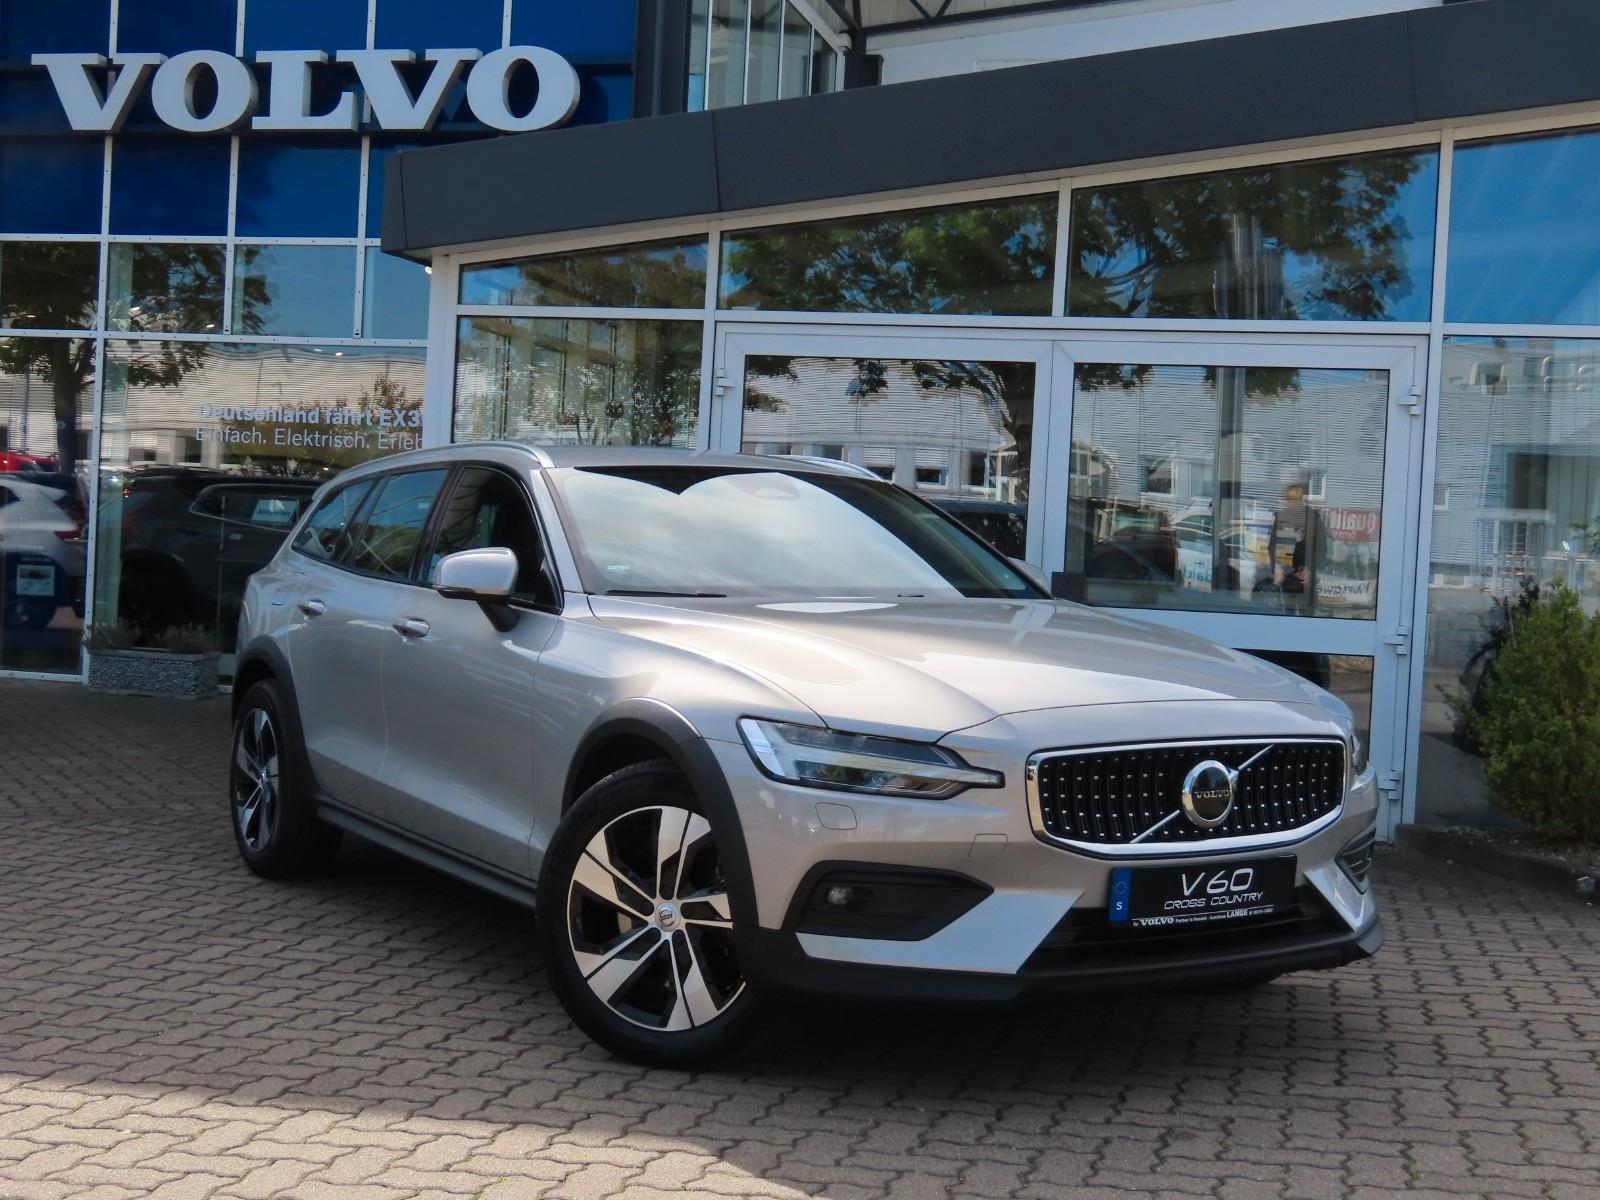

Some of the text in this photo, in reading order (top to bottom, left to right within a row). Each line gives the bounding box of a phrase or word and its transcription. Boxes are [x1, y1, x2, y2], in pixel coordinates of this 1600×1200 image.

[31, 45, 580, 132] VOLVO
[196, 402, 423, 428] Deutschland fährt EX3
[195, 427, 266, 444] Einfach.
[274, 428, 370, 449] Elektrisch.
[1194, 790, 1230, 799] VOLVO
[1181, 867, 1254, 897] V60
[1115, 901, 1123, 911] S
[1163, 891, 1264, 910] CROSS COUNTRY
[1140, 917, 1174, 926] VOLVO
[1226, 909, 1248, 918] LANGE
